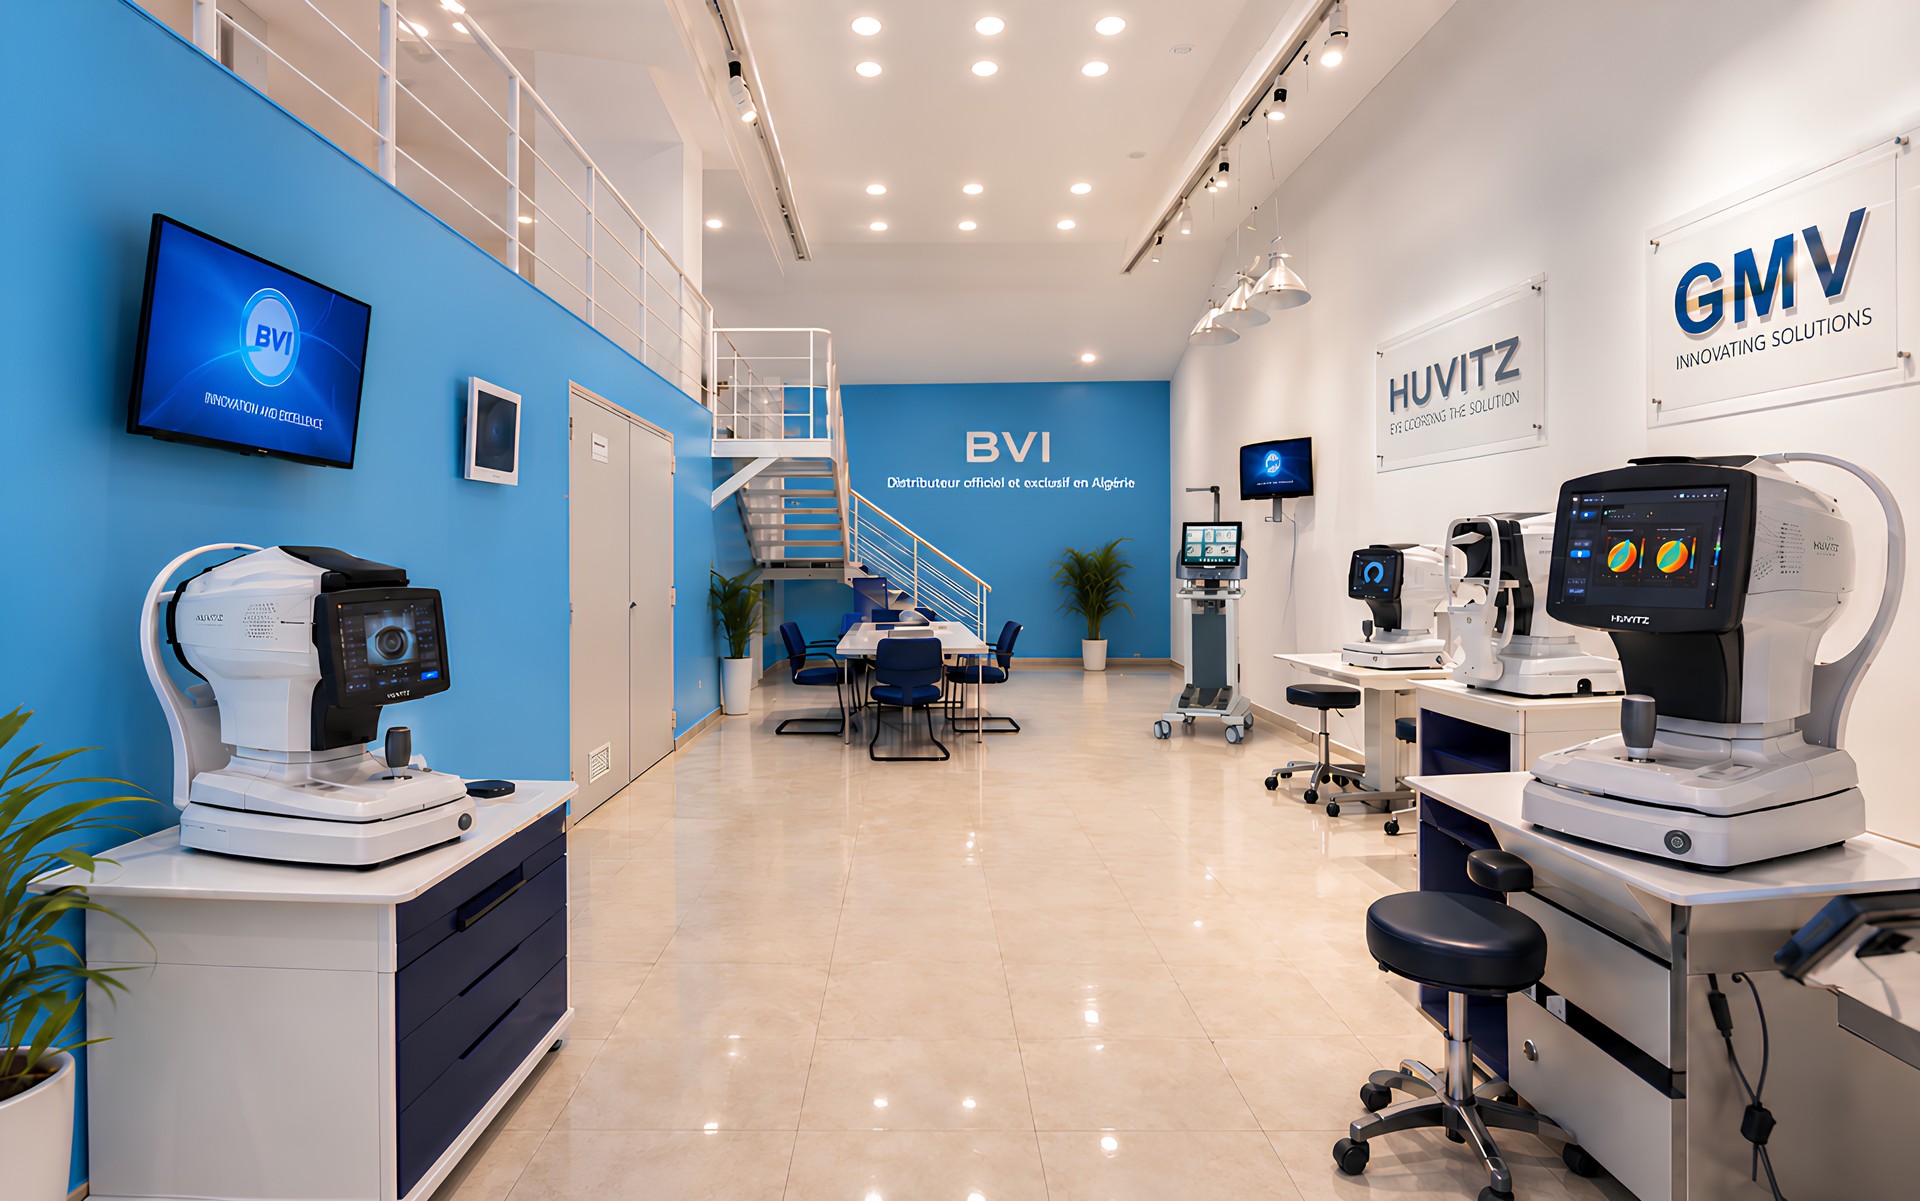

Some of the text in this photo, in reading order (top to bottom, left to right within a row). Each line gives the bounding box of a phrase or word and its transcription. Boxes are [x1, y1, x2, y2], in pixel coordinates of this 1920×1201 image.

[1674, 206, 1867, 335] GMV
[255, 324, 293, 356] BVI
[1676, 307, 1873, 370] INNOVATING SOLUTIONS
[1390, 336, 1520, 413] HUVITZ
[1470, 390, 1520, 416] SOLUTION
[966, 431, 1051, 463] BVI
[887, 476, 961, 489] Distributeur
[963, 476, 1005, 489] officiel
[1008, 478, 1021, 489] et
[1023, 476, 1070, 489] exclusif
[1073, 479, 1089, 489] en
